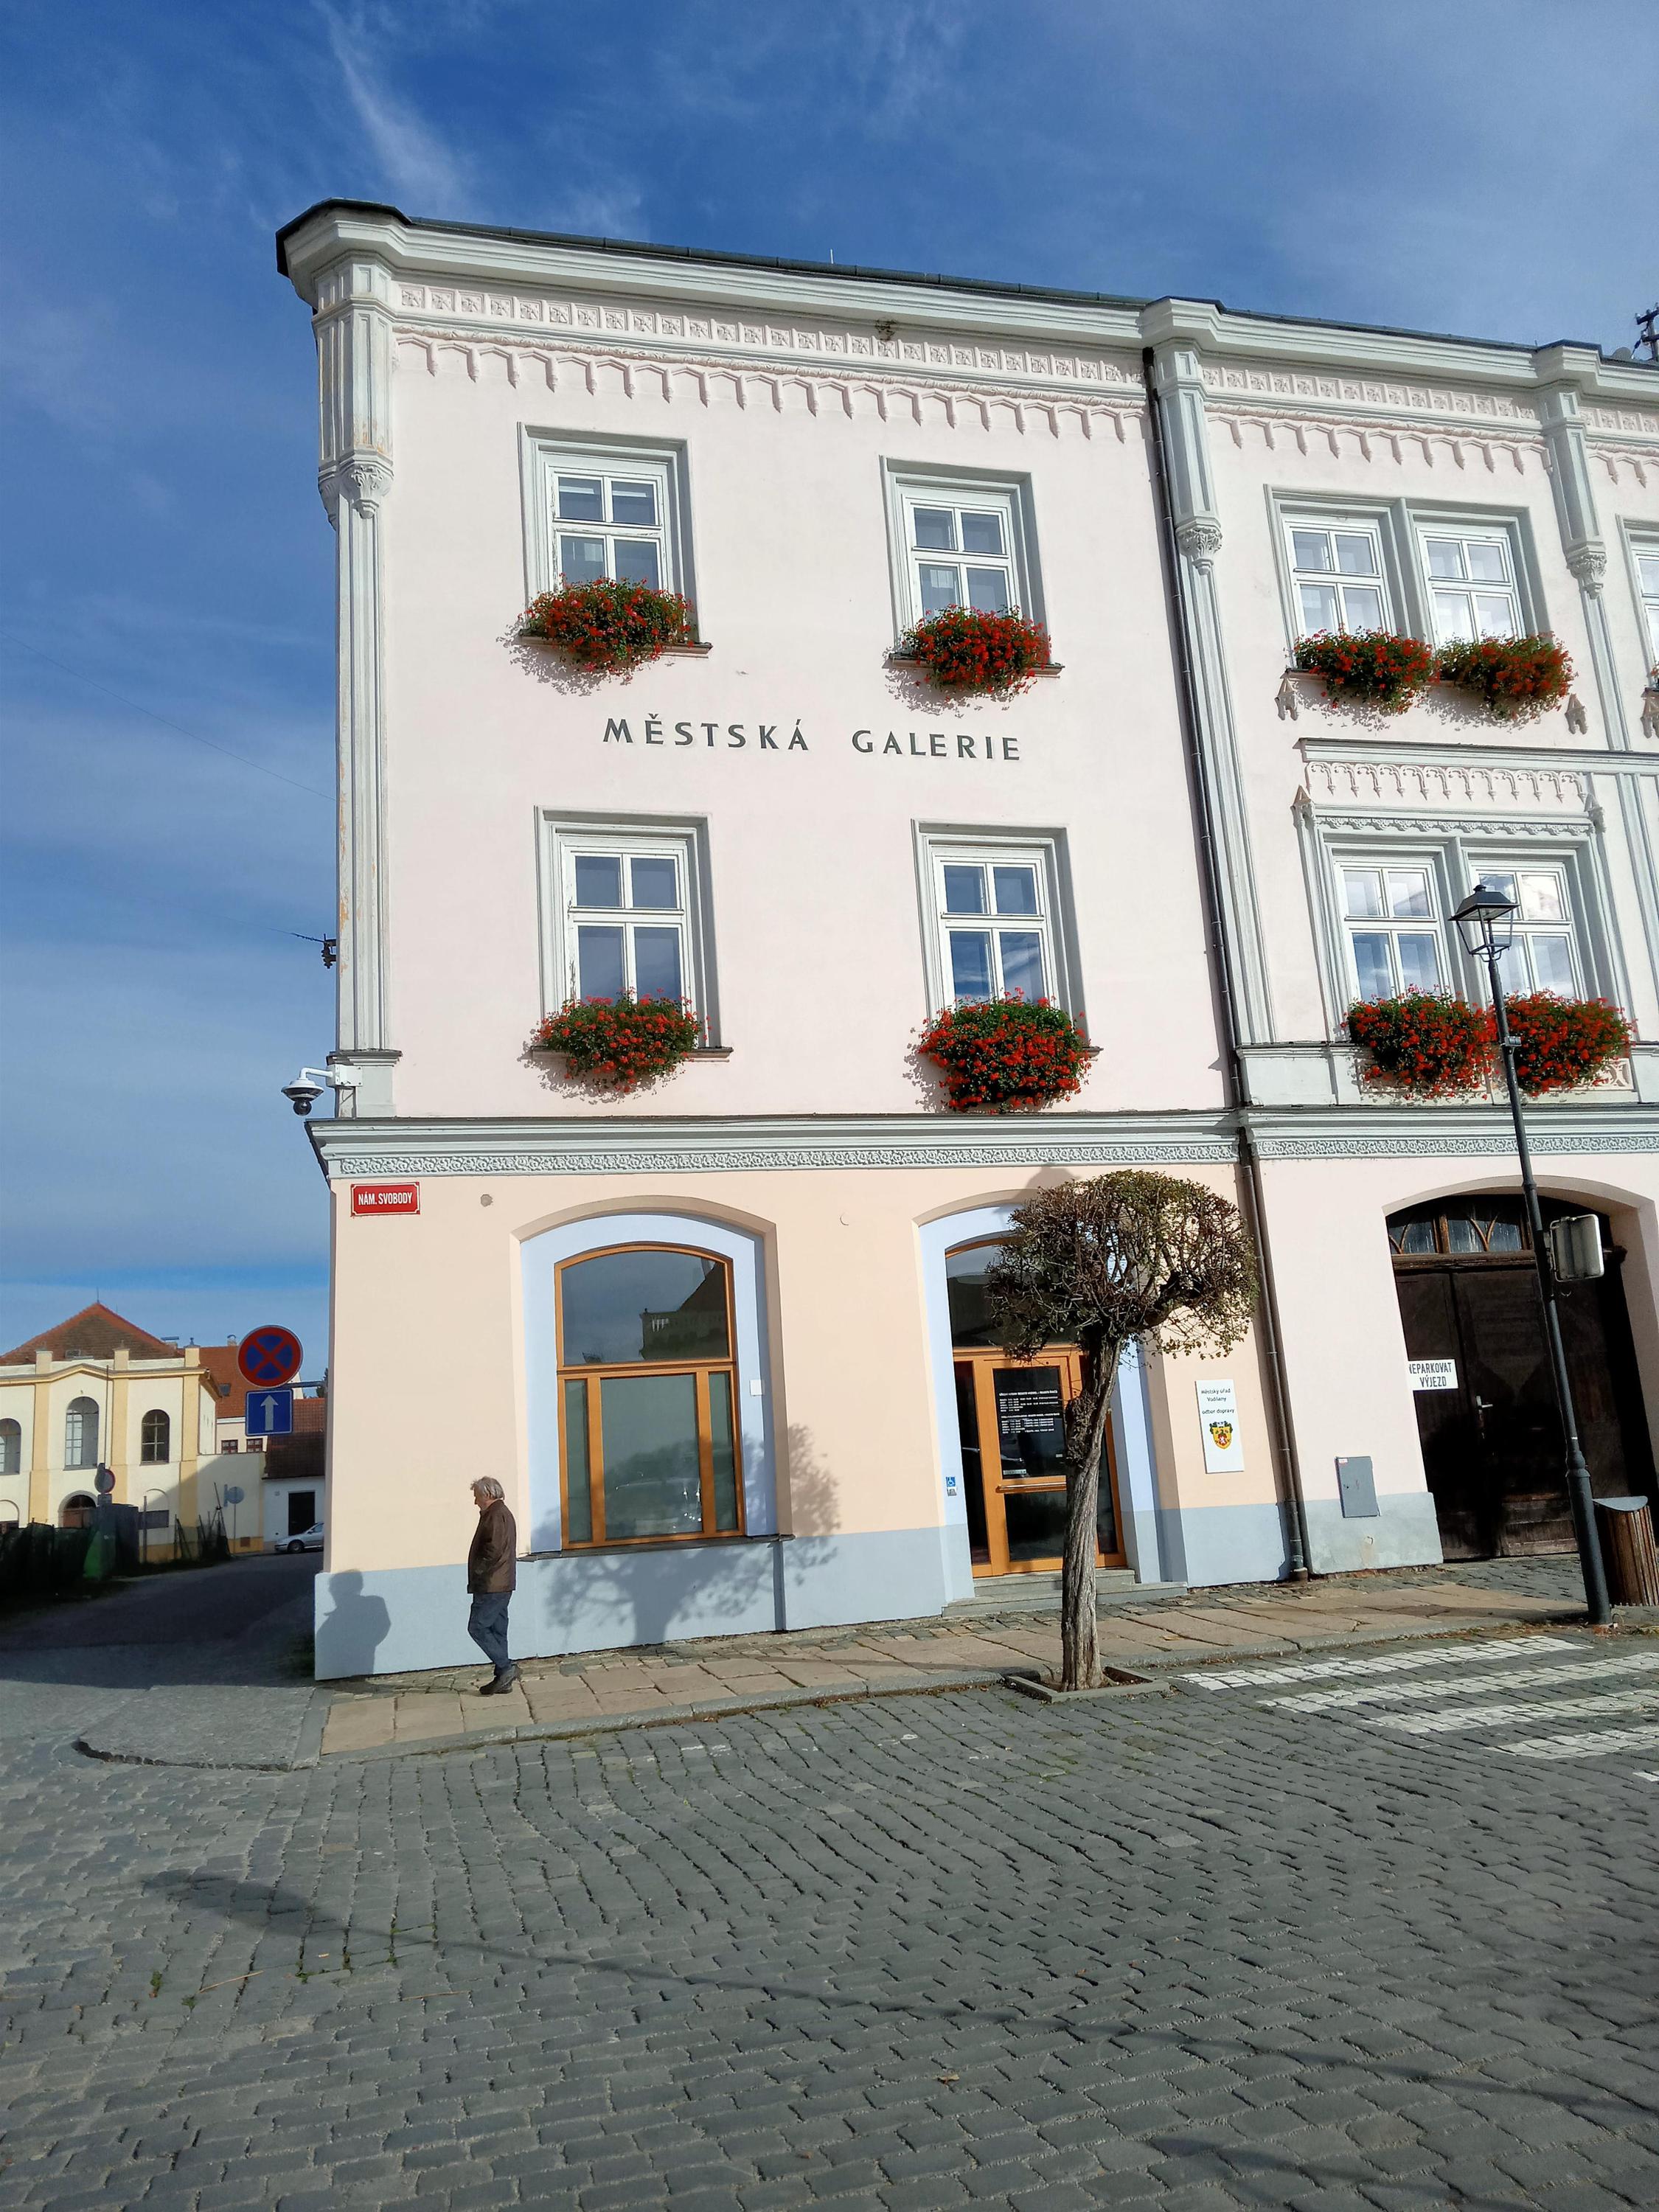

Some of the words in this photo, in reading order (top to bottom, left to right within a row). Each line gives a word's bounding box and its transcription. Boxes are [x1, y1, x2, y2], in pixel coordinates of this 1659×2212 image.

[603, 713, 809, 751] MĚSTSKÁ
[852, 729, 1020, 761] GALERIE
[358, 1192, 377, 1206] NÁM.
[378, 1192, 412, 1204] SVOBODY
[1419, 1374, 1447, 1388] VÝJEZD
